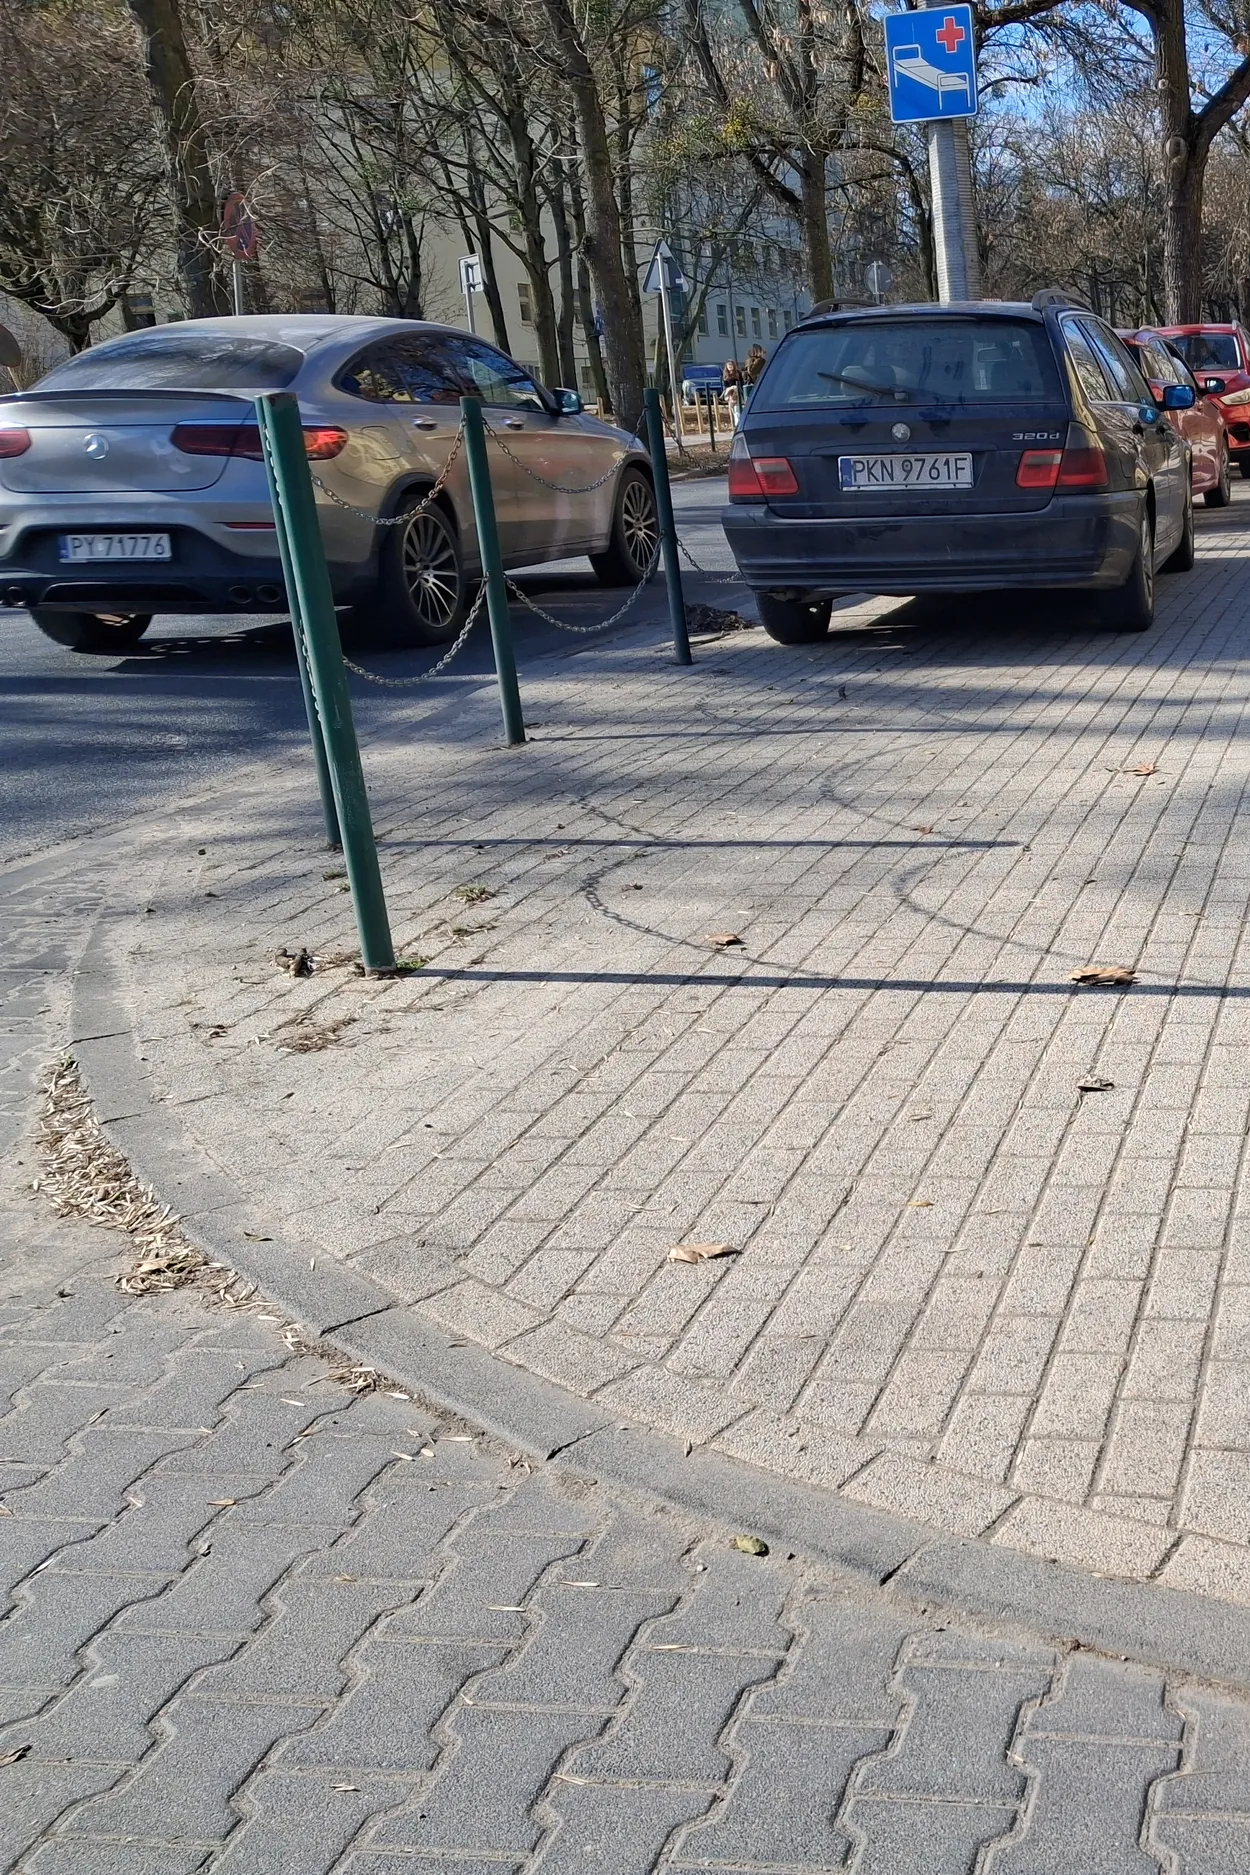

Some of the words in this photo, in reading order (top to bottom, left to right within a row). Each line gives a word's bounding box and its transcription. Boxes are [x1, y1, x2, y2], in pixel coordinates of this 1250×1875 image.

[1012, 432, 1060, 440] 320d
[852, 460, 894, 482] PKN
[901, 458, 967, 481] 9761F
[70, 537, 95, 556] PY
[103, 536, 165, 556] 71776
